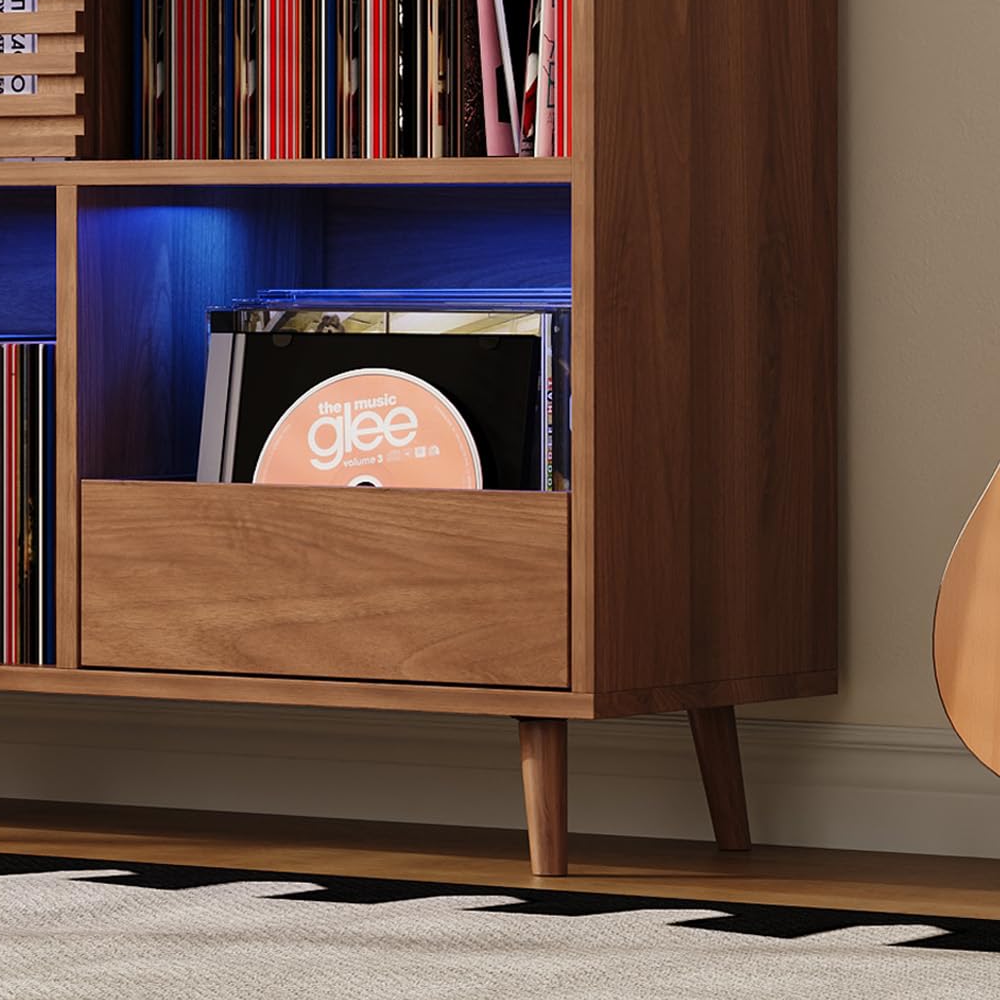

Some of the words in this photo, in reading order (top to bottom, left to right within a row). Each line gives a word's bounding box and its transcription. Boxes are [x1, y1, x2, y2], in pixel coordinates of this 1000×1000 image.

[318, 401, 341, 414] the
[354, 393, 397, 410] music
[308, 402, 418, 470] glee
[343, 456, 376, 467] volume
[377, 454, 384, 464] 3
